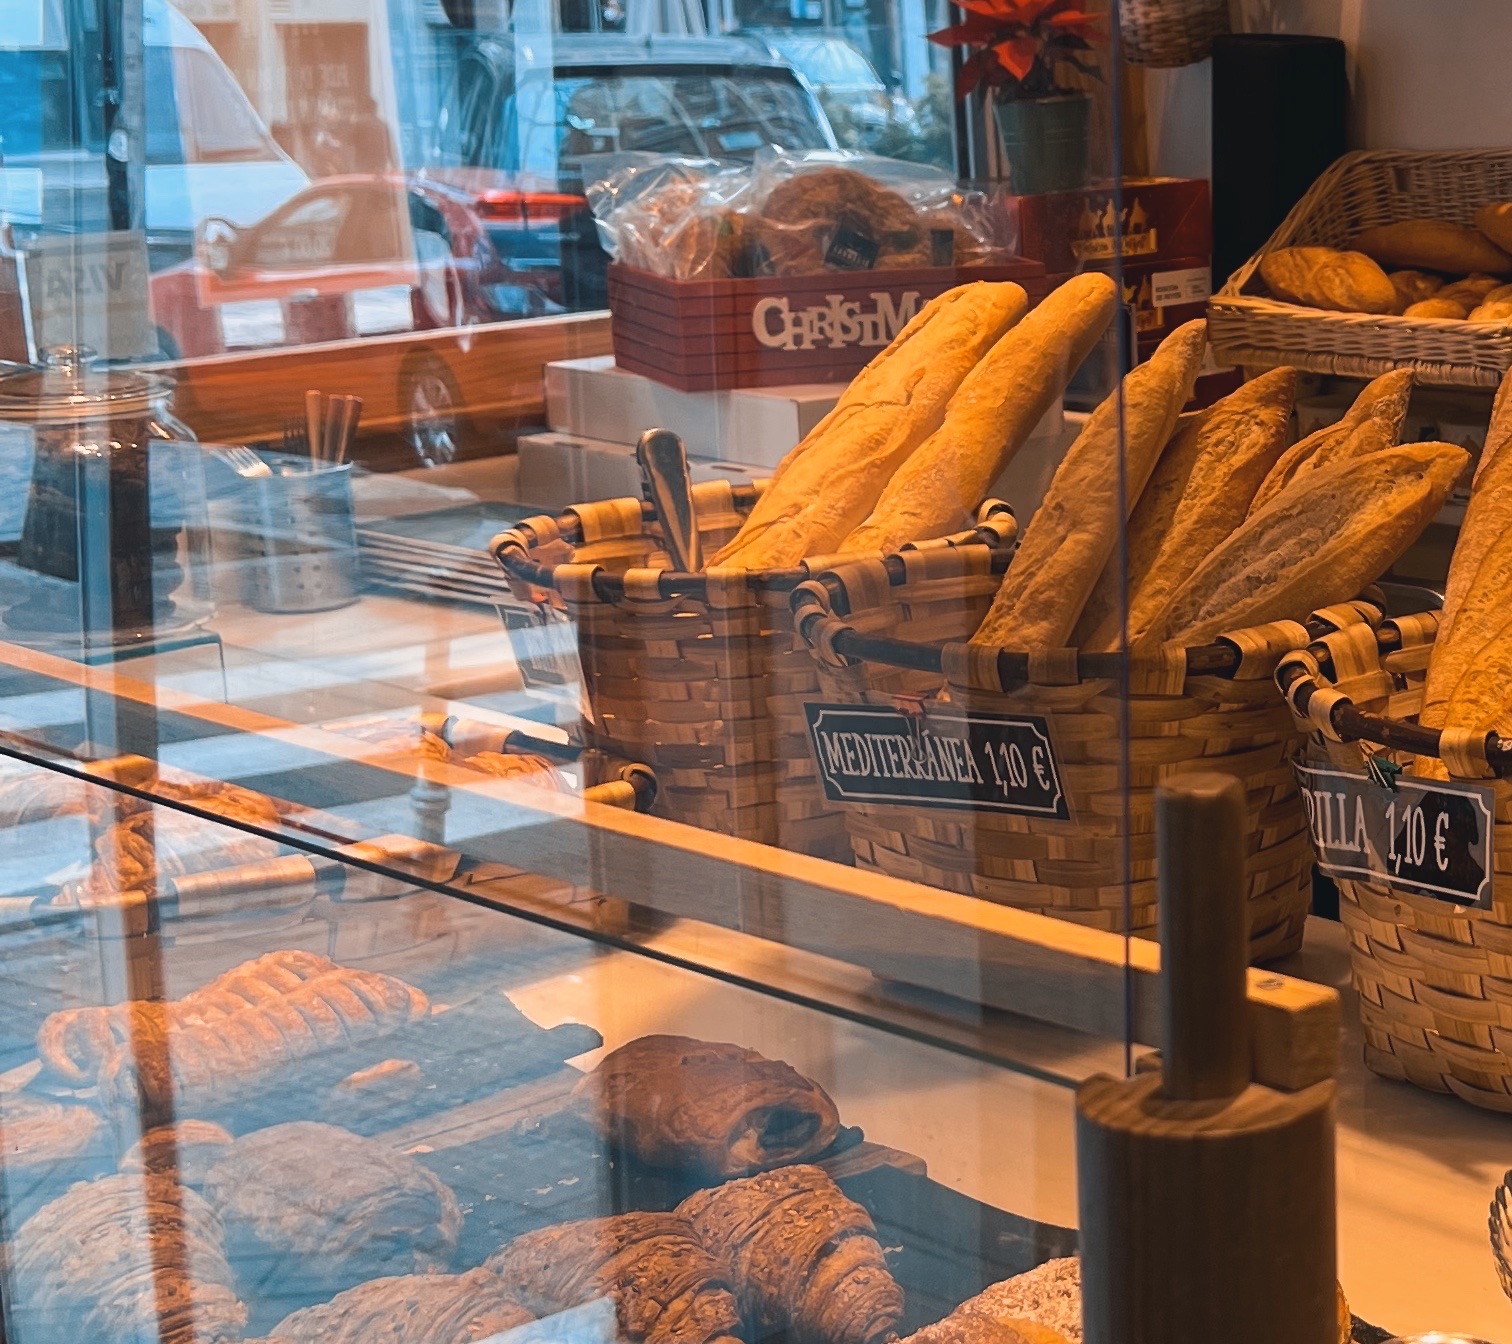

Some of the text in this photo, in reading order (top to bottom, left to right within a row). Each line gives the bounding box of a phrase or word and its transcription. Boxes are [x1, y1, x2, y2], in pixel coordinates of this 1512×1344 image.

[752, 291, 930, 351] CHRISTM
[820, 729, 1050, 798] MEDITERRÁNEA 1,10 €
[1301, 786, 1449, 875] RILLA 1,10 €
